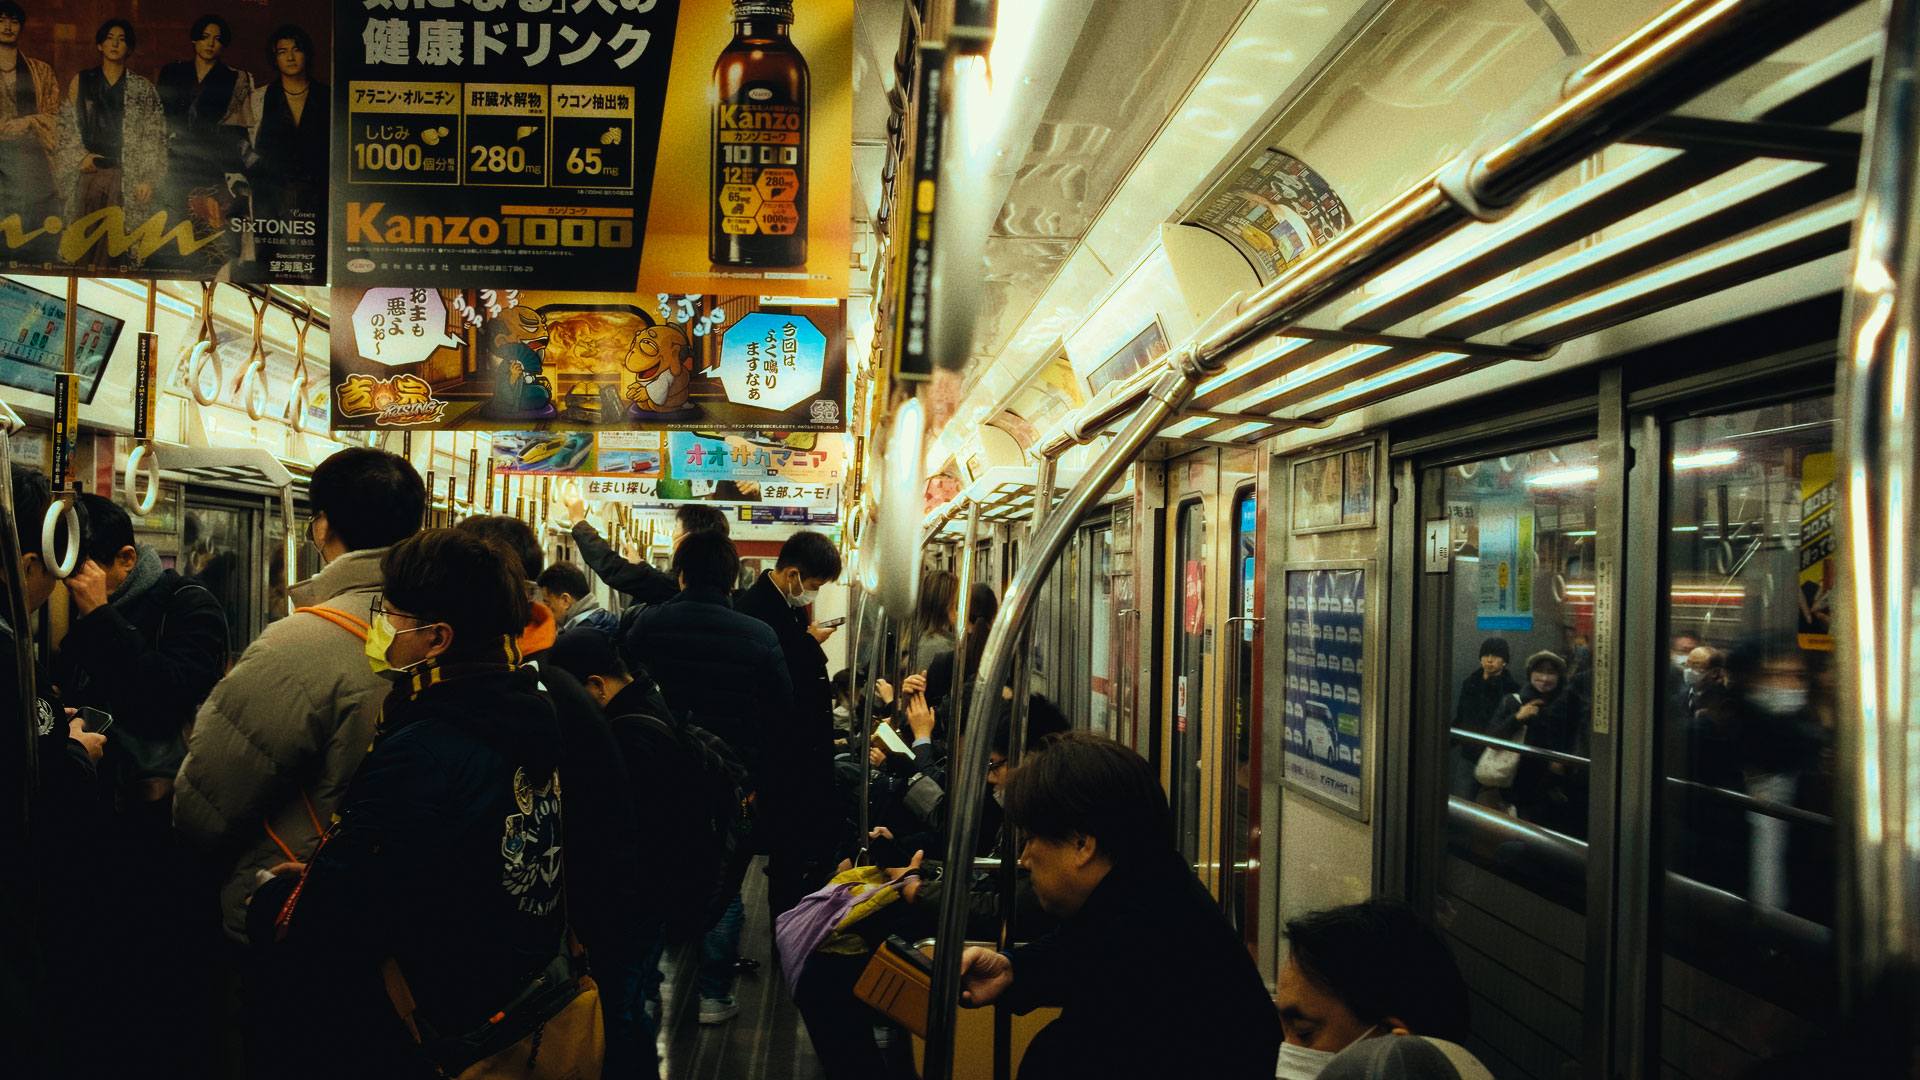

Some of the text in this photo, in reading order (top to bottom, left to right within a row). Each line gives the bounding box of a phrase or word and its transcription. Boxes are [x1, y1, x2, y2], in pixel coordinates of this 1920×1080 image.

[362, 18, 652, 70] 健康ドリンク
[355, 89, 455, 106] アラニン・オルニチン
[471, 91, 542, 108] 肝臓水解物
[557, 93, 629, 110] ウコン抽出物
[720, 104, 800, 130] Kanzo
[366, 124, 410, 141] しじみ
[231, 217, 316, 236] SixTONES
[270, 260, 315, 273] 望海風斗
[386, 297, 407, 336] 悪よ
[409, 288, 427, 337] お主も
[763, 329, 780, 390] よく鳴り
[685, 443, 828, 469] オオサカマニア
[589, 480, 650, 495] 住まい探し
